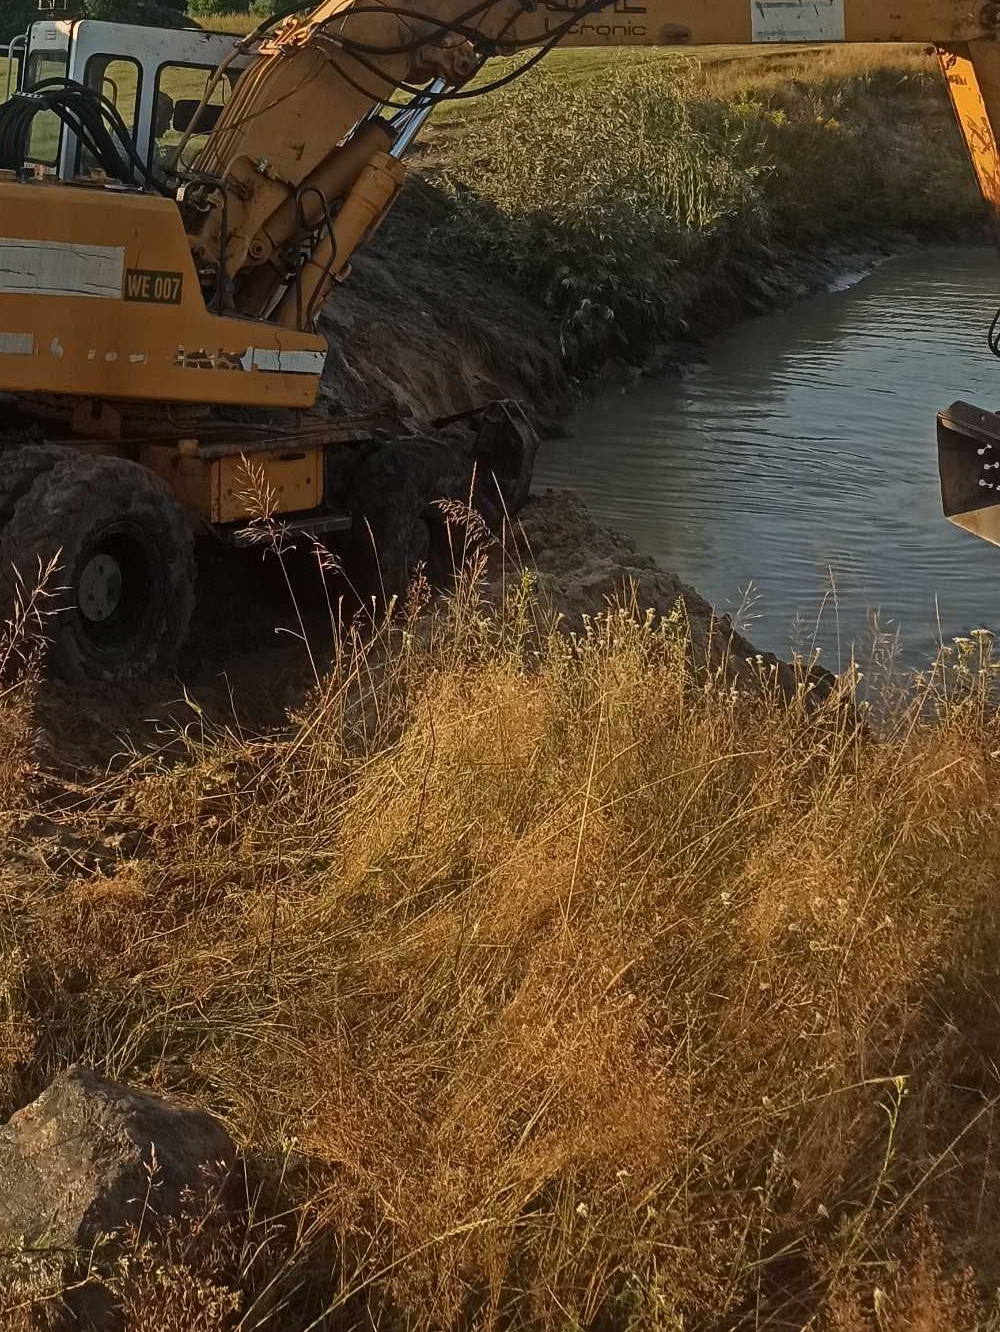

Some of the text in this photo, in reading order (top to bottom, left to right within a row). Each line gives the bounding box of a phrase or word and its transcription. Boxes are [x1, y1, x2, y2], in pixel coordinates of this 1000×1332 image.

[545, 17, 648, 37] Ltronic
[128, 274, 180, 300] WE 007
